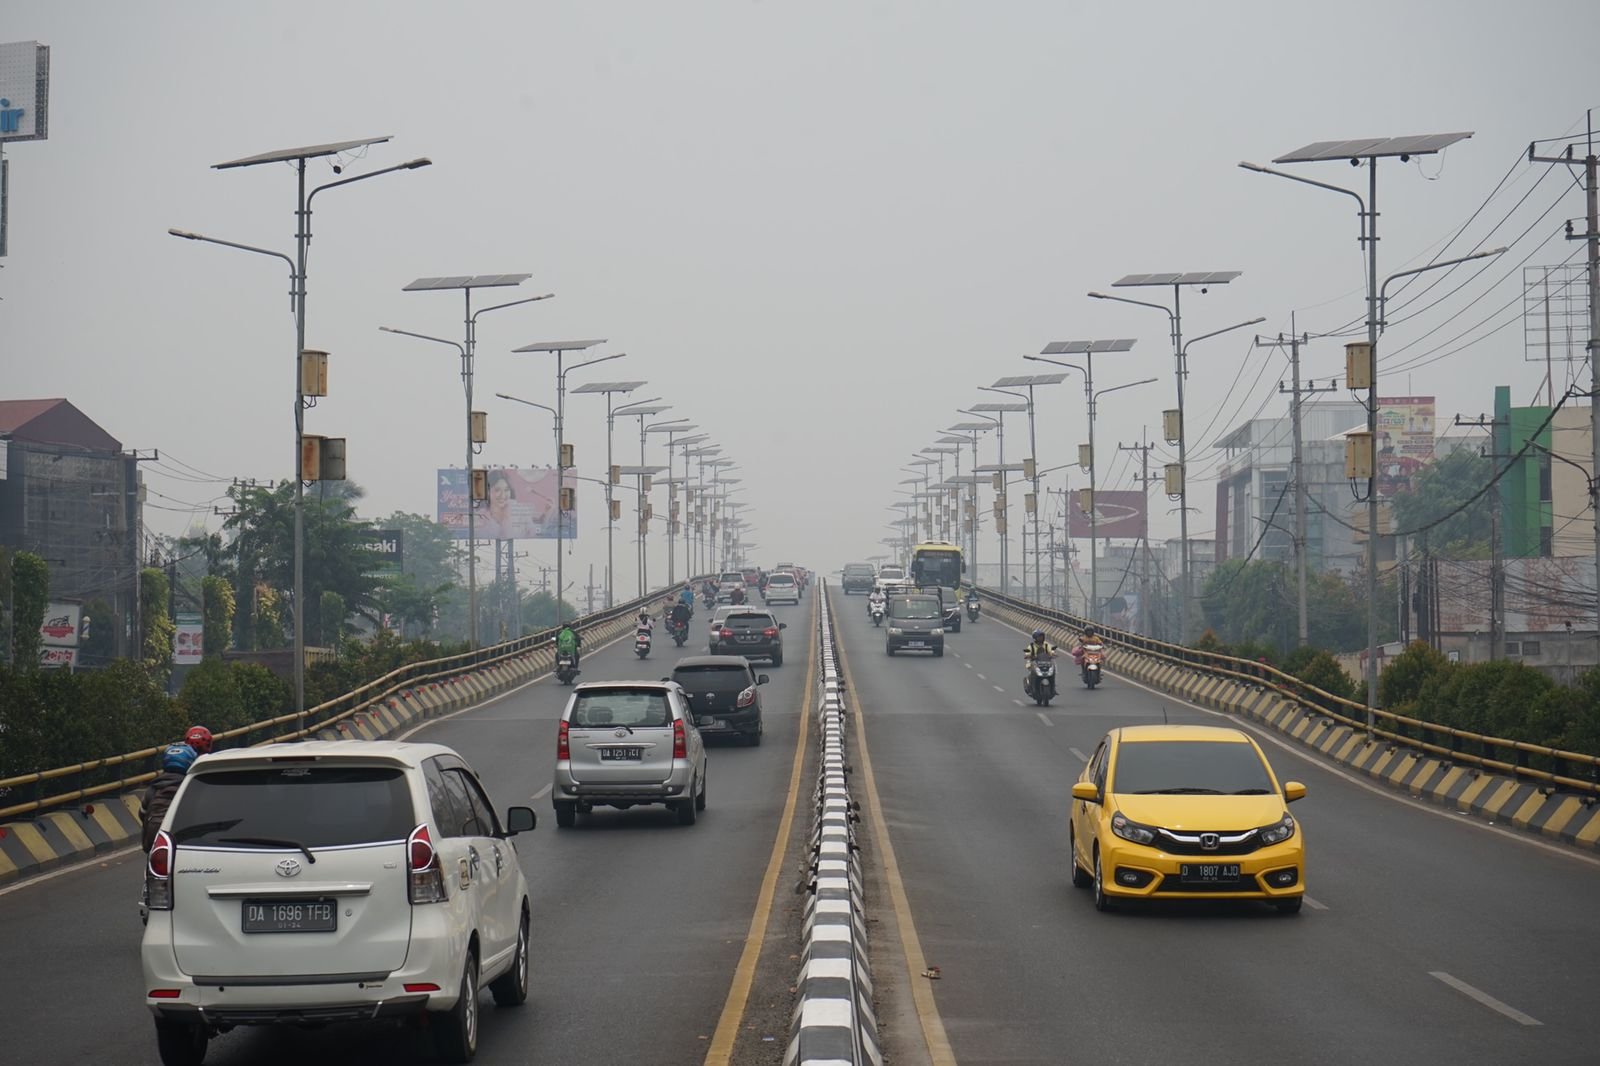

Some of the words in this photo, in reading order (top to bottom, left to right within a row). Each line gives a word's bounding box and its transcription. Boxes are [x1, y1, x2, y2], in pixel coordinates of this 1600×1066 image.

[1182, 865, 1189, 876] D
[1199, 865, 1219, 876] 1807
[249, 906, 265, 921] DA
[272, 905, 302, 921] 1696
[307, 904, 332, 920] TFB
